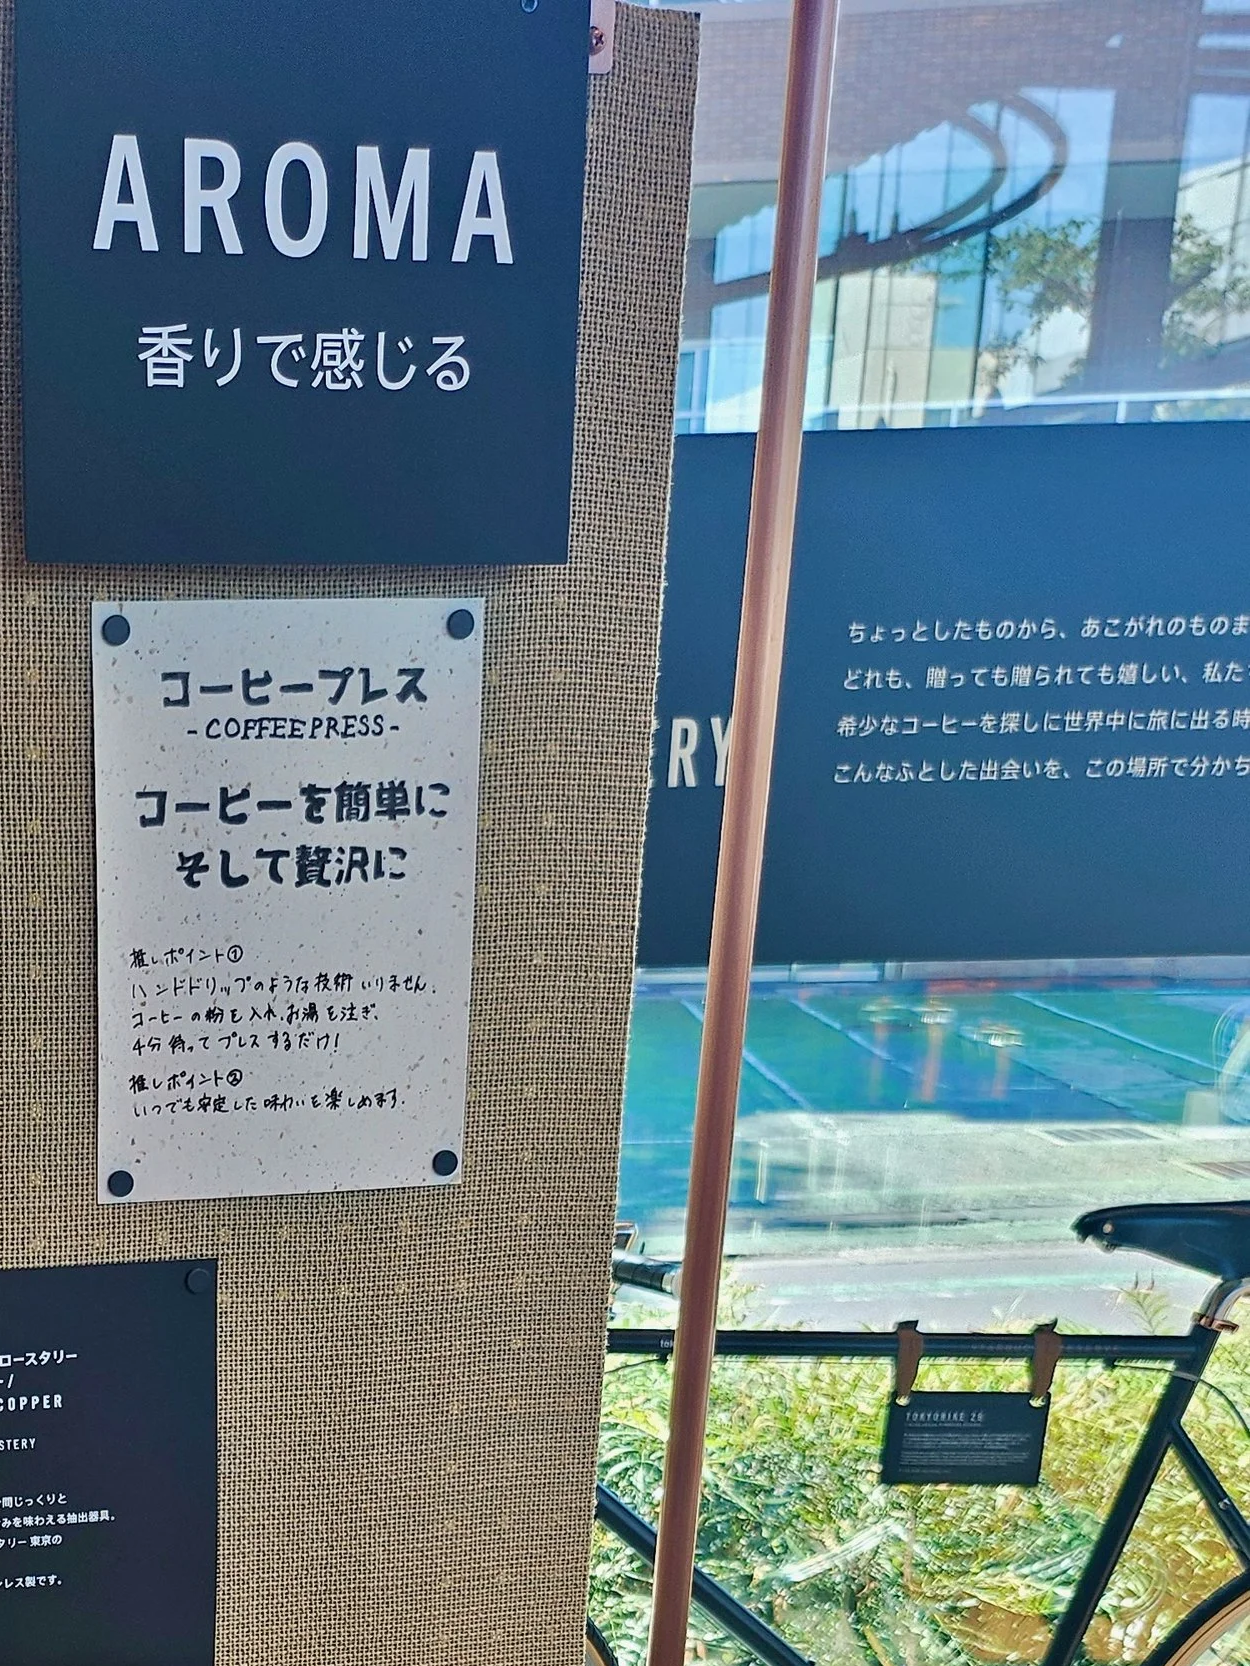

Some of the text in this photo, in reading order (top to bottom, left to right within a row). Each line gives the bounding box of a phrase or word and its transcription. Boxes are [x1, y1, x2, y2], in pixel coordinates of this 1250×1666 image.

[93, 134, 514, 264] AROMA
[137, 323, 471, 391] 香りで感じる
[161, 667, 428, 708] コーヒープレス
[843, 661, 1250, 690] どれも、贈っても贈られても嬉しい、私た
[652, 716, 733, 788] RY
[135, 780, 450, 828] コーヒーを簡単に
[176, 845, 407, 889] そして贅沢に
[0, 1349, 78, 1367] ロースタリー
[30, 1534, 63, 1548] 東京の
